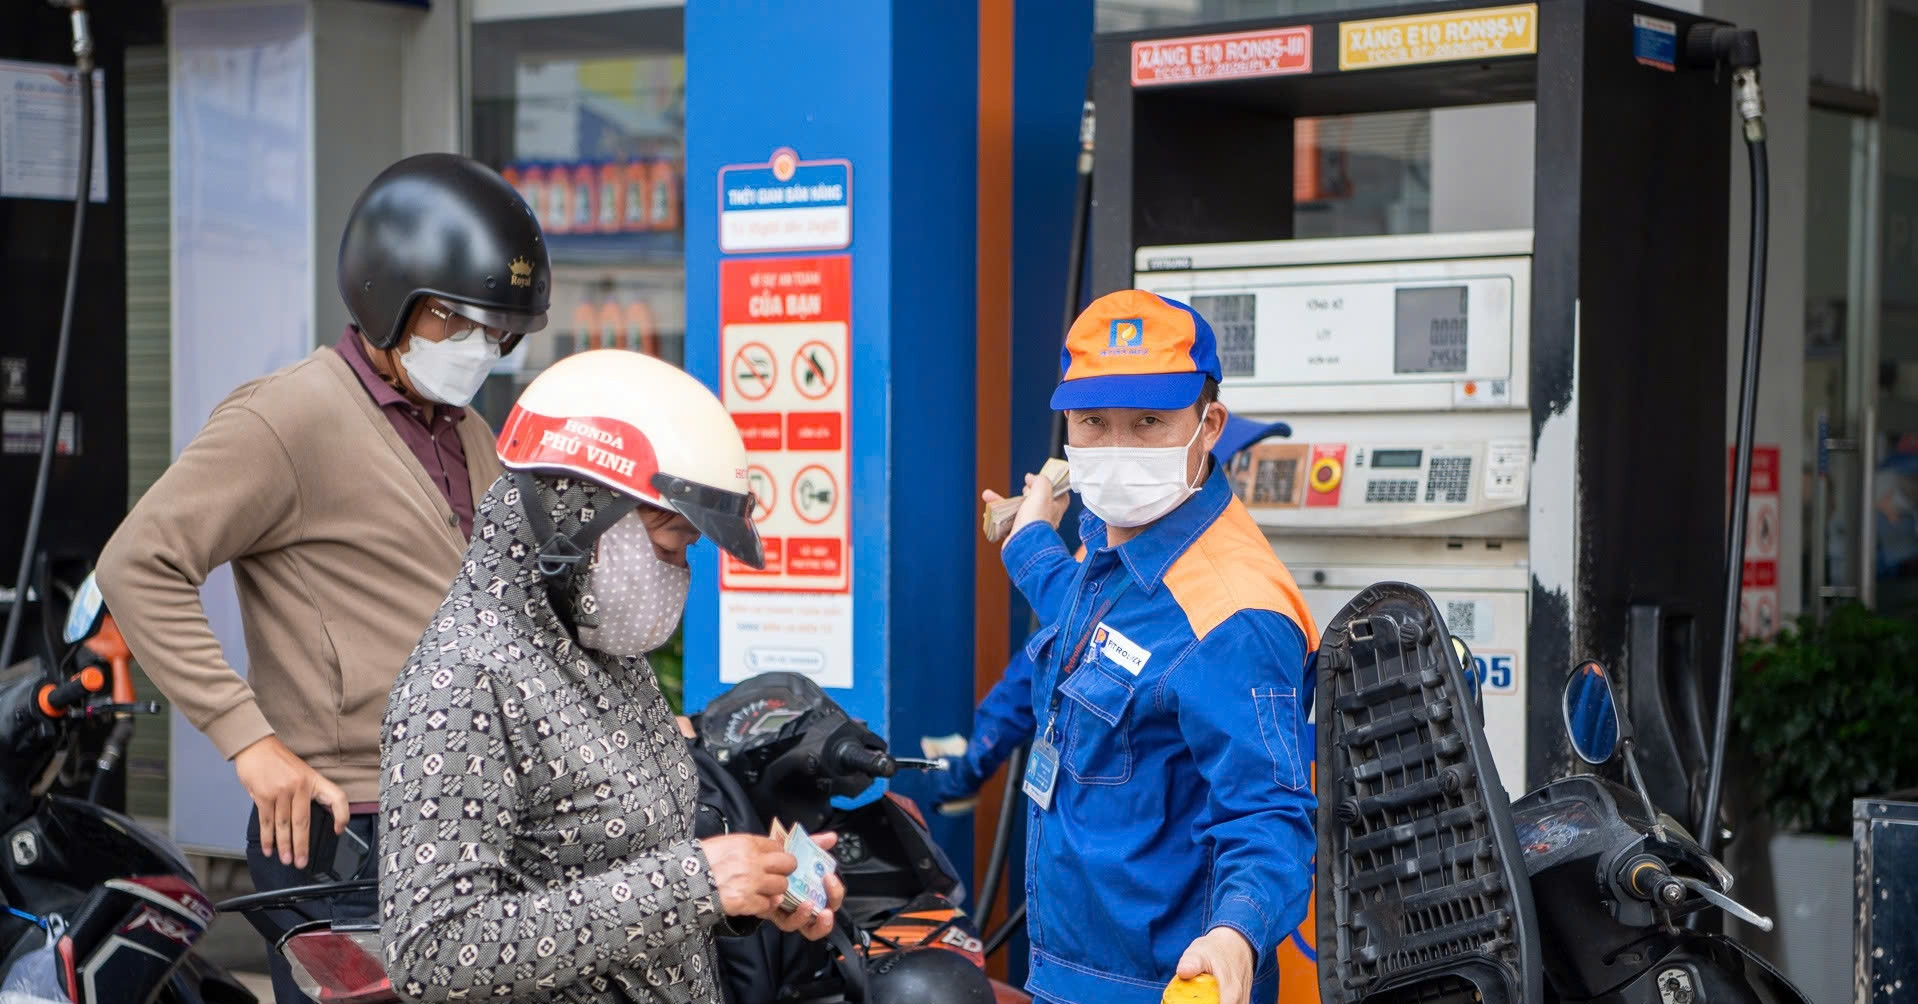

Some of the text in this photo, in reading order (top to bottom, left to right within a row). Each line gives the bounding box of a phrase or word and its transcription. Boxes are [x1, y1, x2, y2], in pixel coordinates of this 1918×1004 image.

[1407, 24, 1440, 46] E10
[1190, 43, 1223, 65] E10
[511, 275, 531, 288] Royal
[564, 418, 624, 450] HONDA
[540, 430, 636, 477] PHÚ VINH
[1107, 639, 1143, 667] PTROLEX
[941, 926, 983, 953] 150
